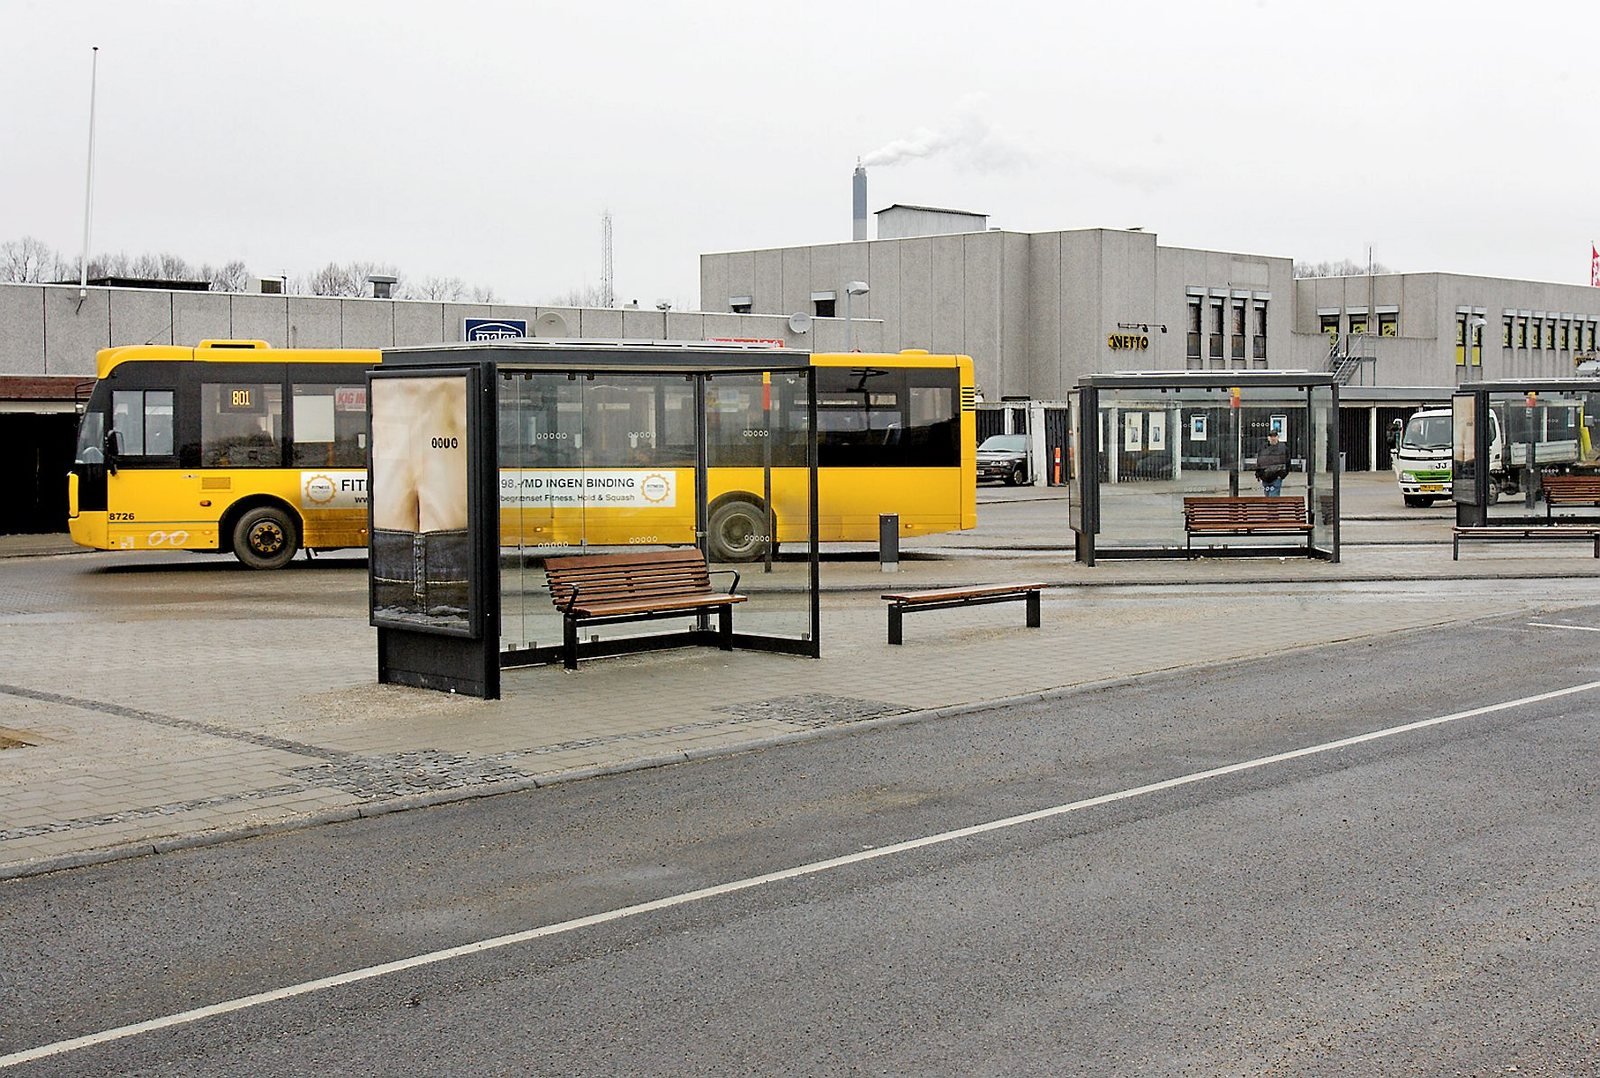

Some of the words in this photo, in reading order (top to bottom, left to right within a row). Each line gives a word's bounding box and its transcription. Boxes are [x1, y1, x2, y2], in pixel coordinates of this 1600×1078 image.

[1114, 335, 1149, 349] NETTO
[232, 390, 250, 406] 801
[546, 478, 583, 488] INGEN
[586, 477, 635, 488] BINDING
[597, 493, 603, 501] &
[605, 493, 635, 502] Squash
[109, 512, 135, 520] 8726
